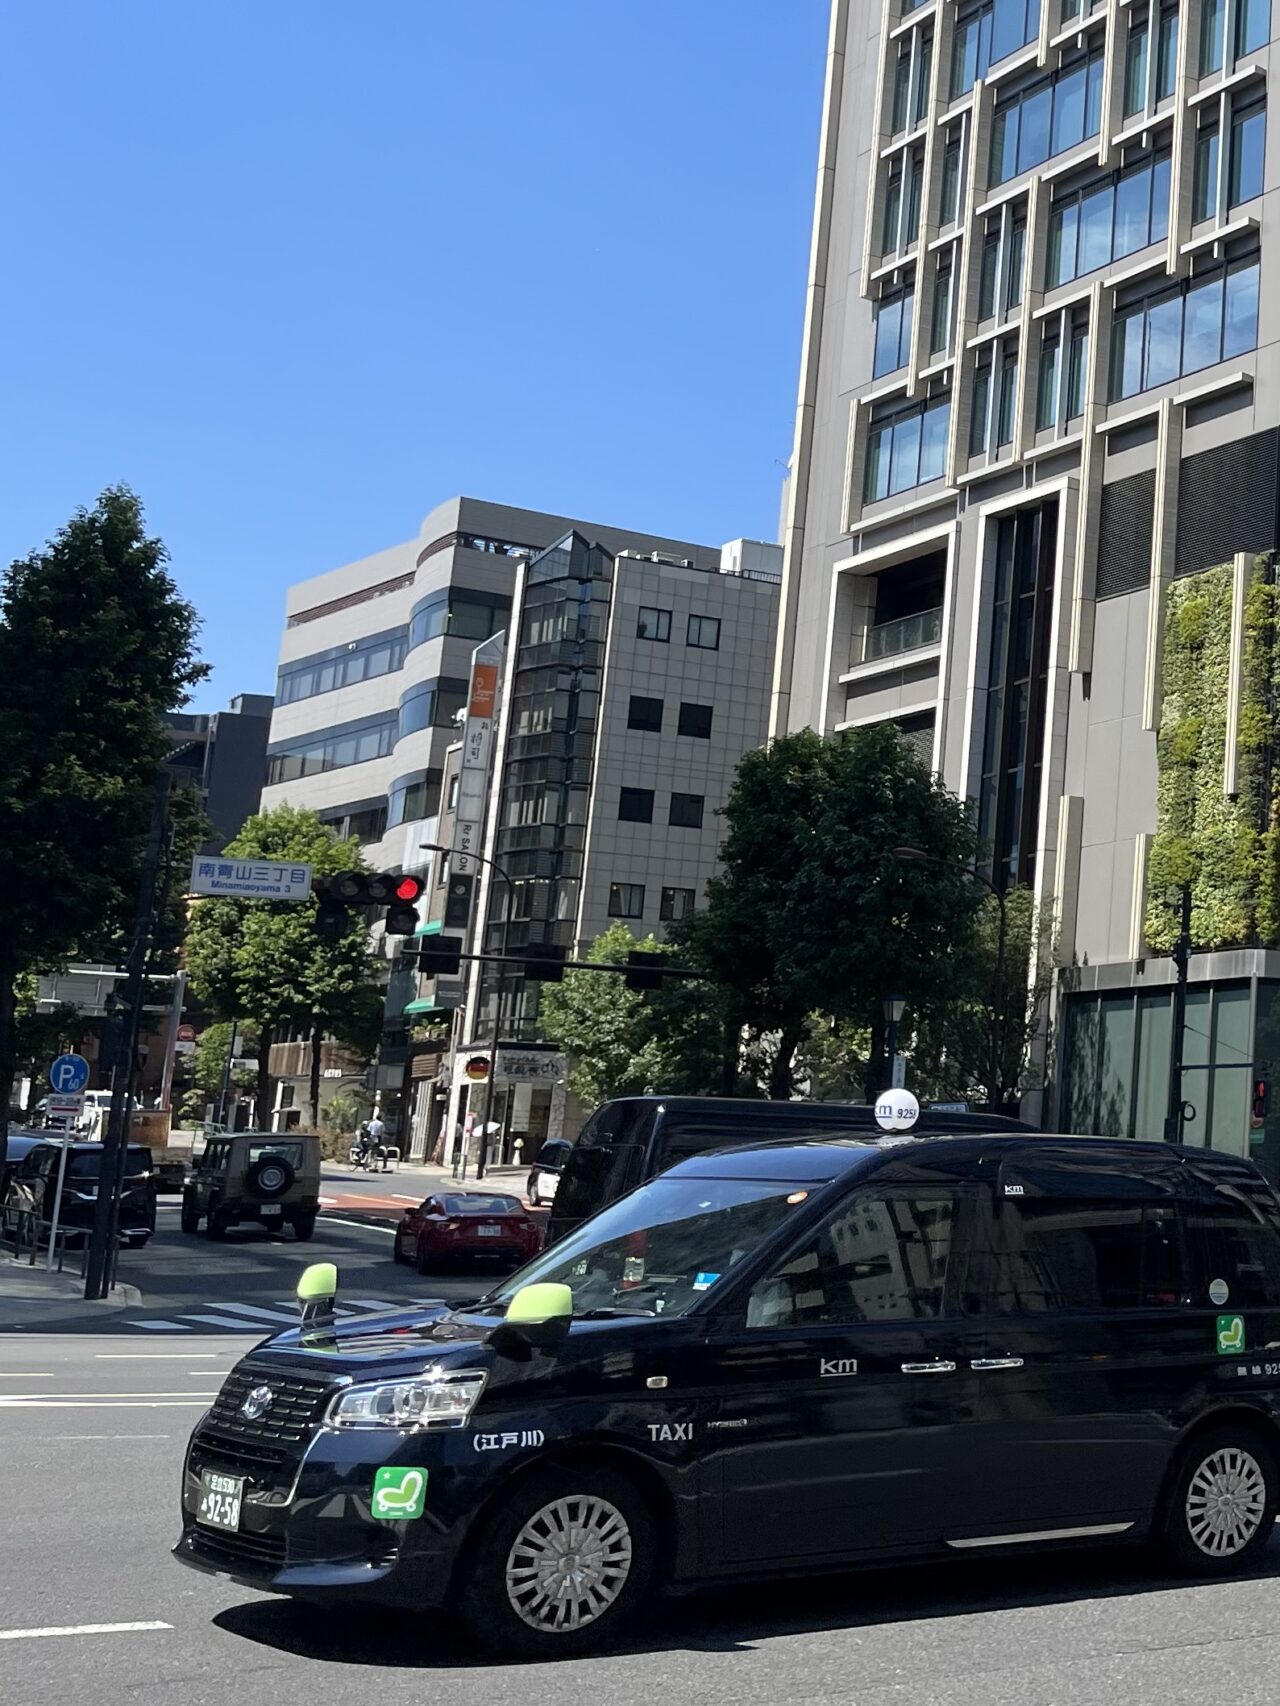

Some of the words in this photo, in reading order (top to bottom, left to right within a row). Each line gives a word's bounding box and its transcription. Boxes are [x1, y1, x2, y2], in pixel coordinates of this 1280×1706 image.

[458, 838, 471, 871] SAON
[199, 863, 305, 883] 南青山三丁目
[211, 880, 280, 893] Minamiaoyama
[284, 884, 291, 893] 3
[59, 1064, 75, 1089] P
[1004, 1184, 1024, 1195] km
[820, 1358, 858, 1377] km
[647, 1423, 693, 1441] TAXI
[206, 1492, 239, 1527] 92-58
